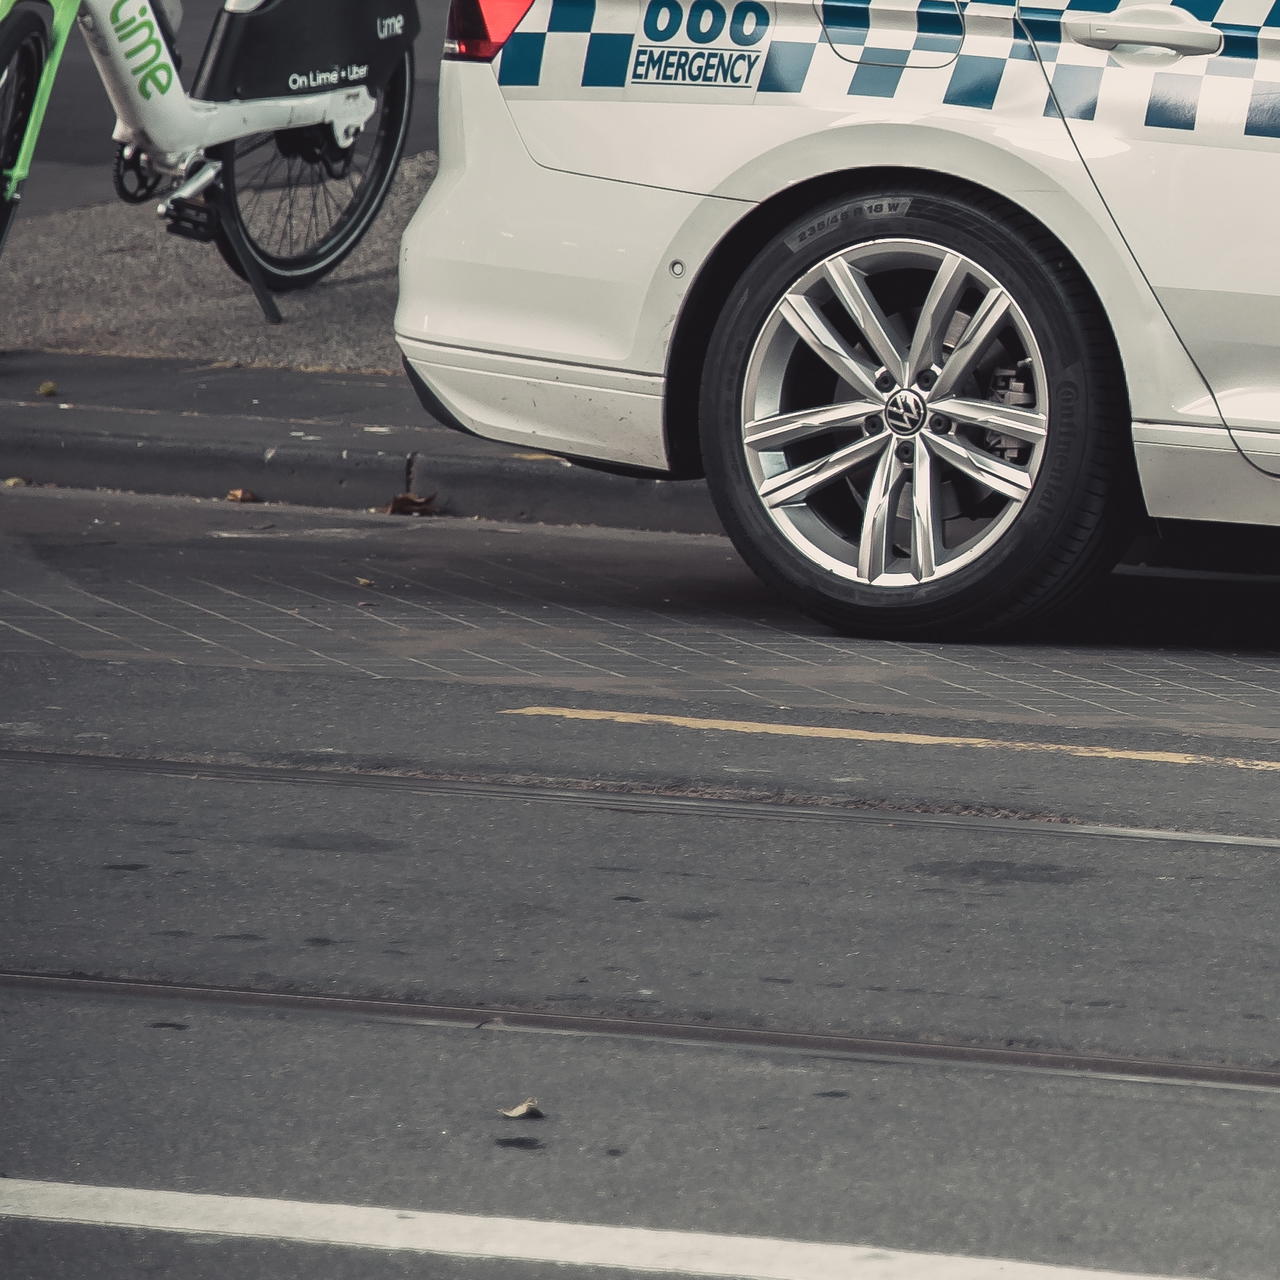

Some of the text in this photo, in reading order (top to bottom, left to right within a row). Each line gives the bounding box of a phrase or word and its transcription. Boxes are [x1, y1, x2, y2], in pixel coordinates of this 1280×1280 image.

[376, 14, 405, 40] Lime
[288, 73, 308, 90] On
[309, 69, 339, 88] Lime
[631, 49, 762, 85] EMERGENCY
